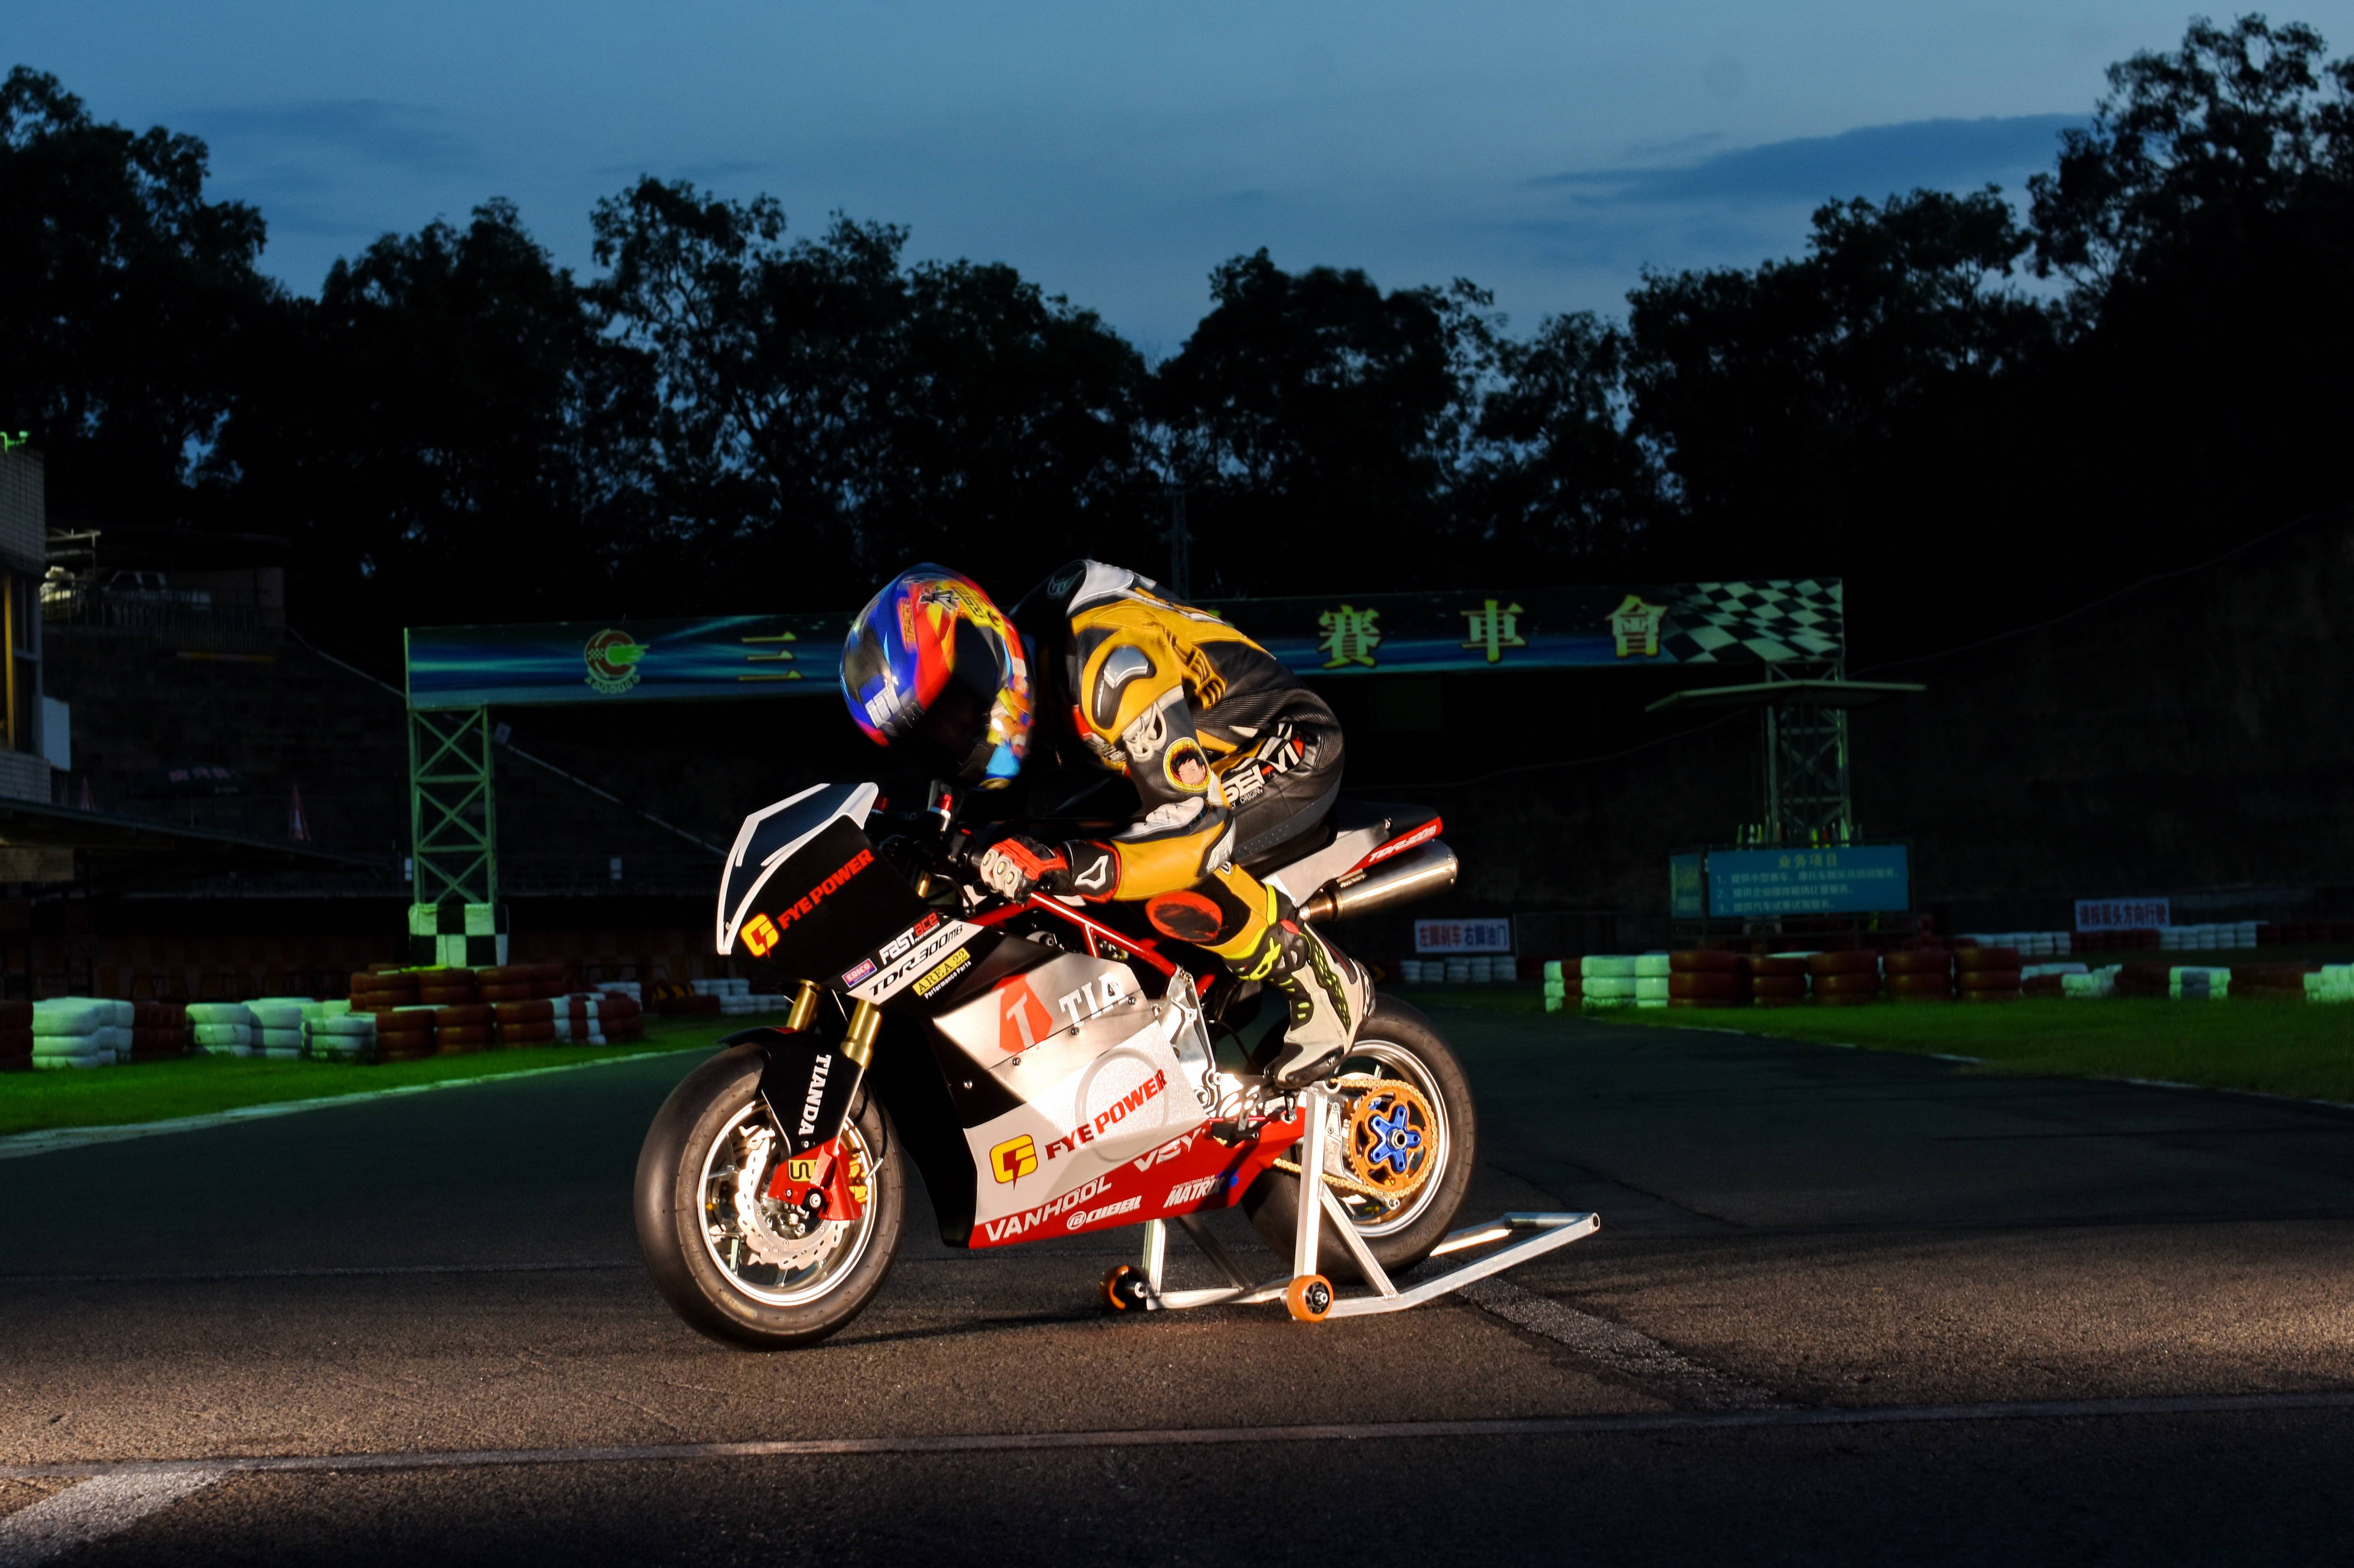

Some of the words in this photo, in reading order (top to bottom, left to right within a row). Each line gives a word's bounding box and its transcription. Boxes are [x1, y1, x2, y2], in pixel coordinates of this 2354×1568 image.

[777, 896, 813, 930] FYE
[809, 848, 875, 905] POWER
[919, 962, 954, 993] AREA
[952, 950, 968, 966] 22
[925, 969, 957, 999] Performance
[956, 960, 972, 975] Parts
[1058, 972, 1129, 1028] TIA
[799, 1054, 832, 1136] TIANDA
[1045, 1123, 1094, 1160] FYE
[1094, 1068, 1167, 1134] POWER
[985, 1176, 1112, 1242] VANHOOL
